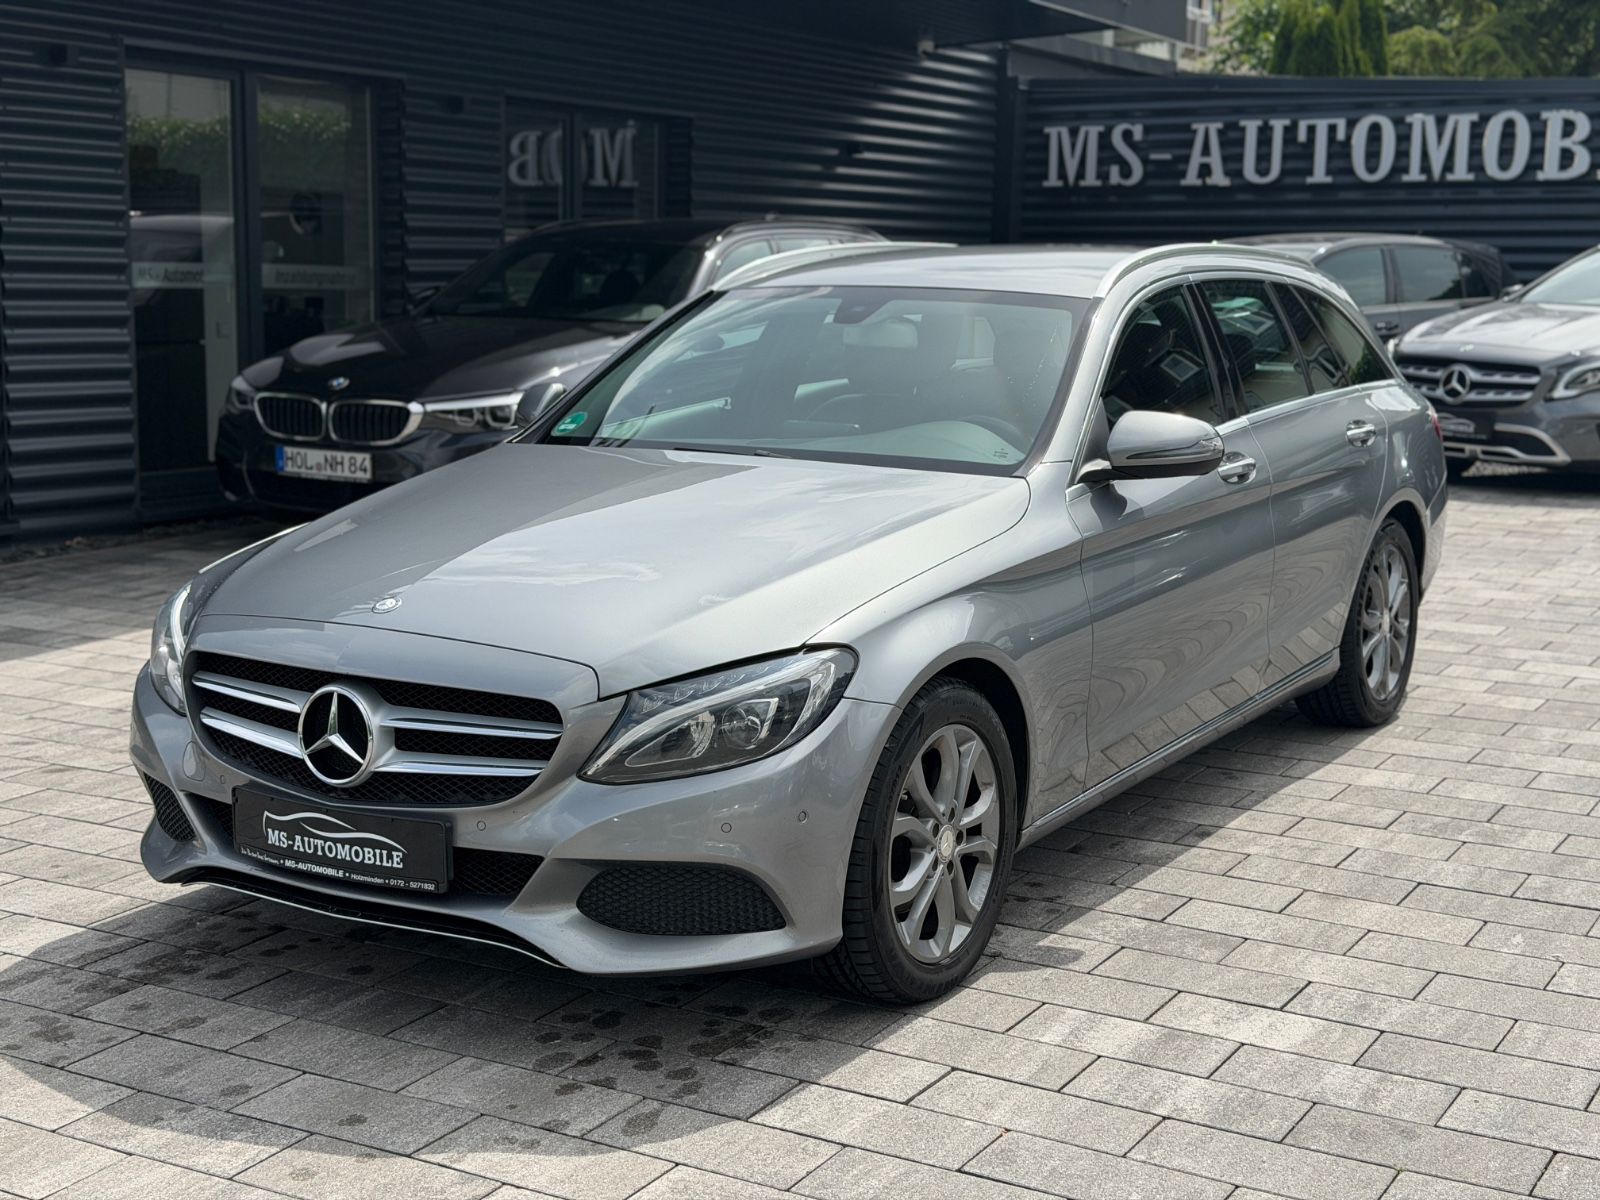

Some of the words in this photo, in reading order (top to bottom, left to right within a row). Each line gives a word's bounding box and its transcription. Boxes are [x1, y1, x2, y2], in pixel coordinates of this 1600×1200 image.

[1042, 109, 1600, 188] MS-AUTOMOB
[286, 450, 313, 471] HOL
[324, 453, 345, 473] NH
[348, 455, 368, 475] 84
[267, 828, 404, 869] MS-AUTOMOBILE
[285, 859, 344, 878] MS-AUTOMOBILE
[389, 879, 405, 888] 0172
